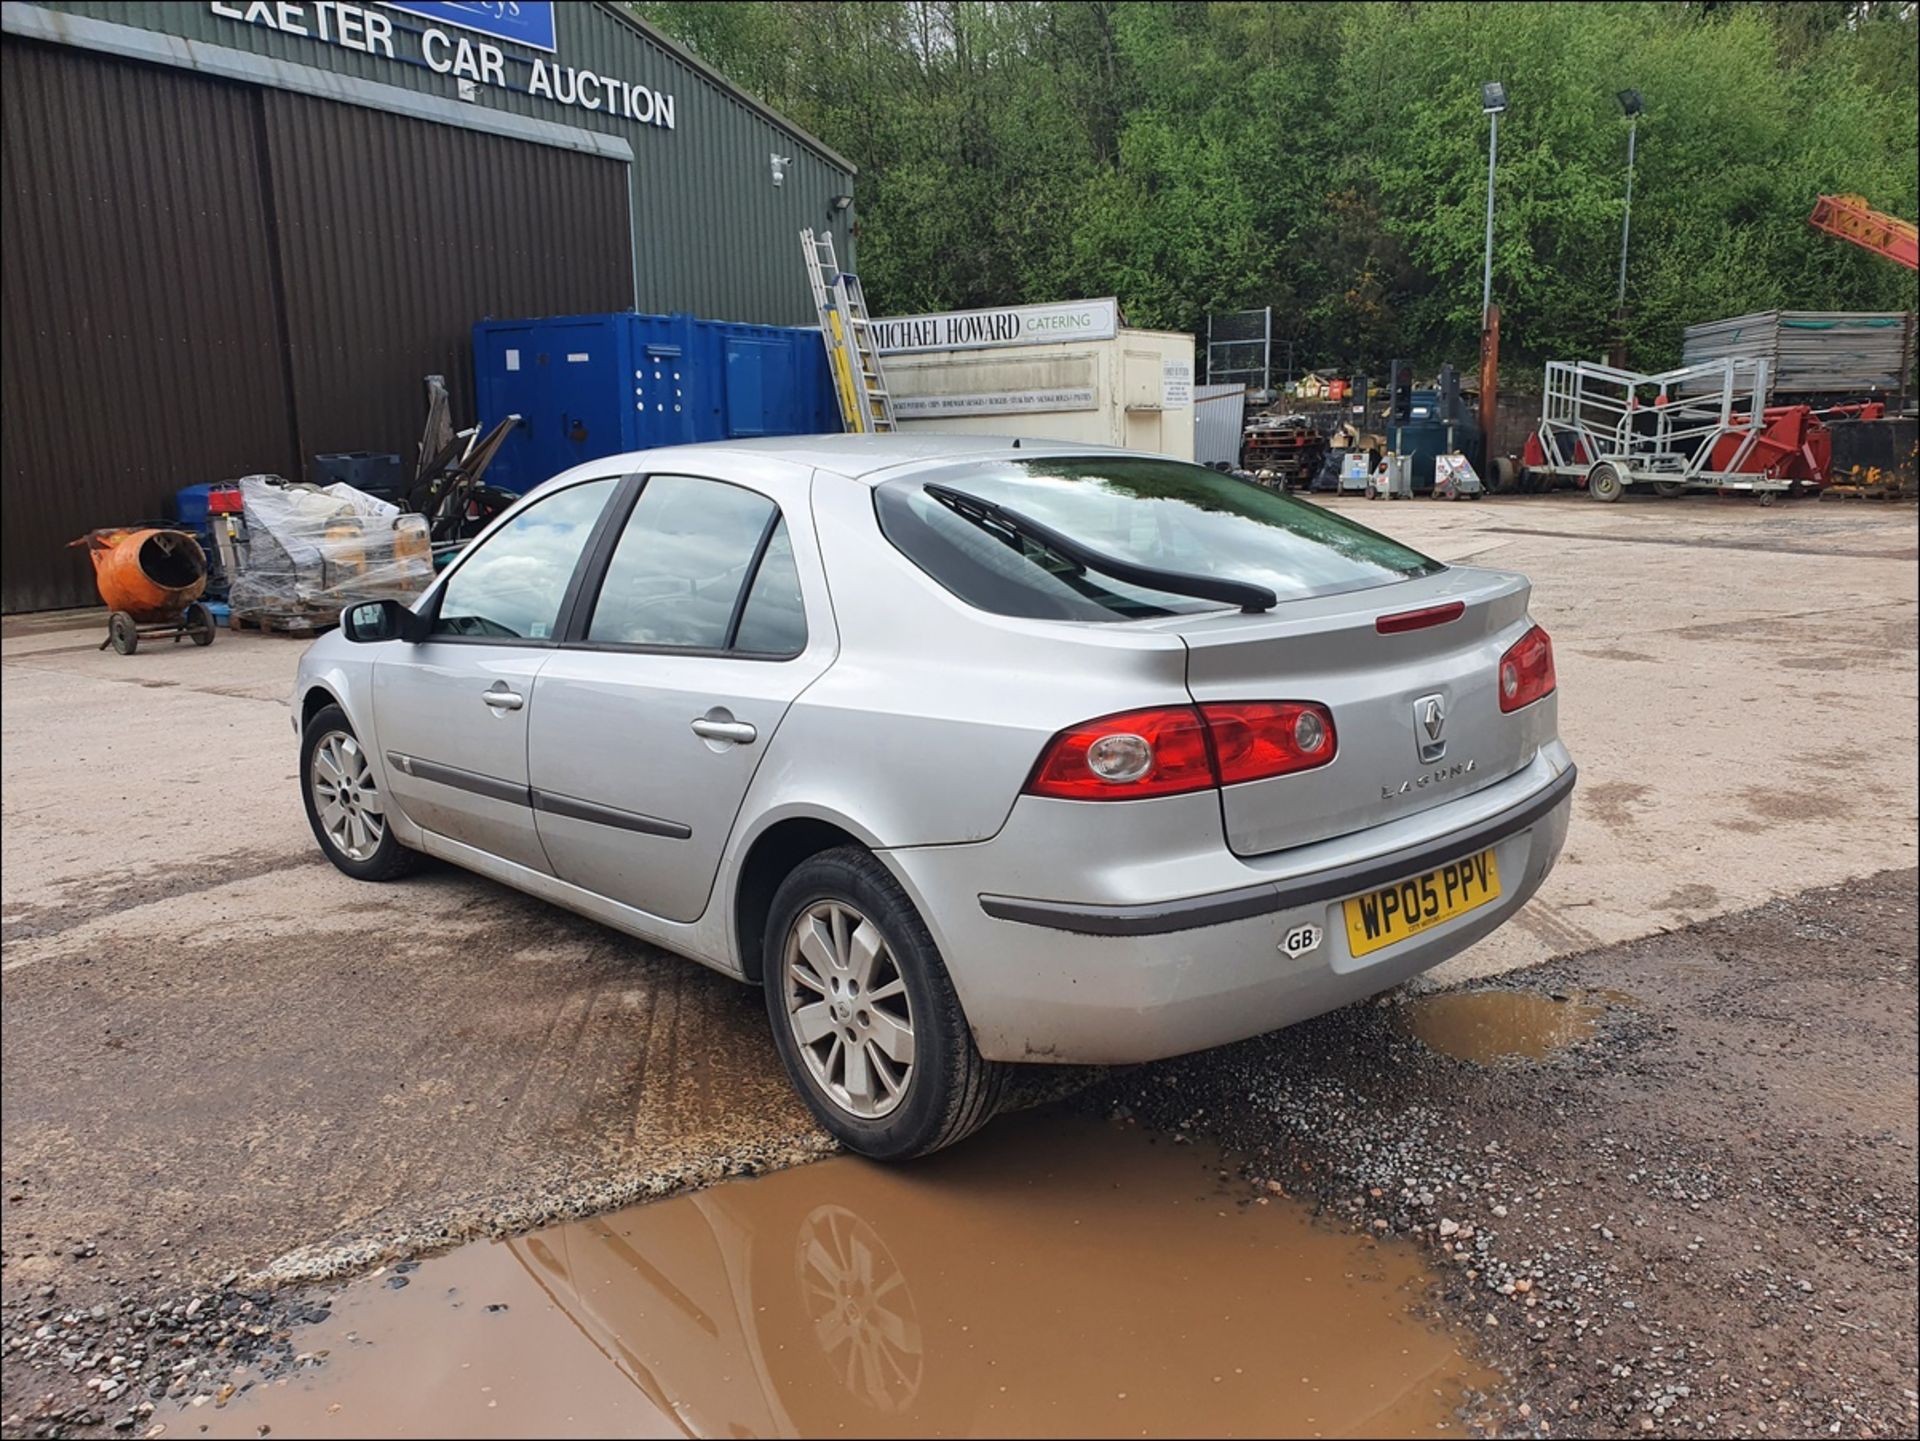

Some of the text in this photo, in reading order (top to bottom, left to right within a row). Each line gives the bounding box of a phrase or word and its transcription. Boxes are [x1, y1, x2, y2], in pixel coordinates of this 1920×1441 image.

[211, 1, 675, 129] XETER CAR AUCTION
[872, 313, 1091, 350] MICHAEL HOWARD CATERING
[1381, 759, 1476, 799] LAGUNA
[1360, 851, 1489, 941] WP05 PPV
[1287, 929, 1313, 951] GB
